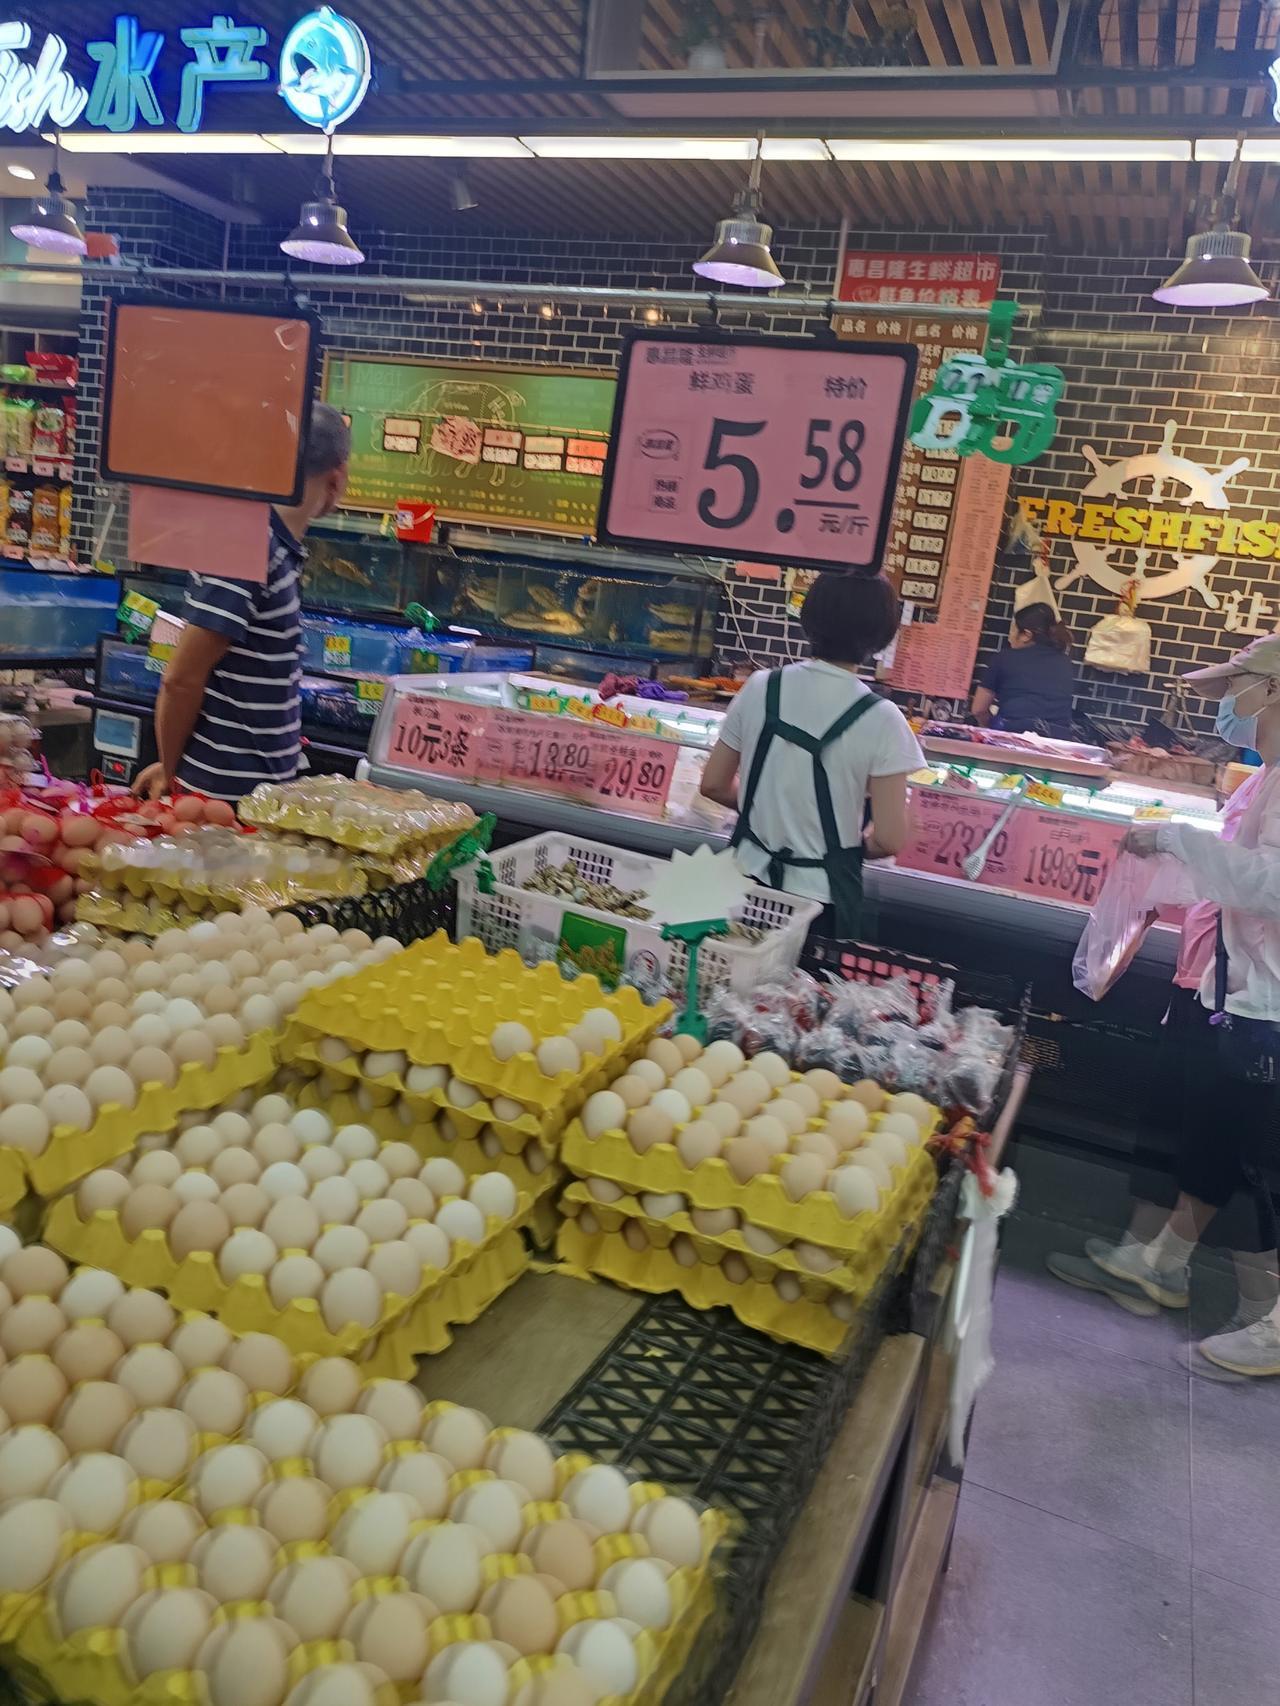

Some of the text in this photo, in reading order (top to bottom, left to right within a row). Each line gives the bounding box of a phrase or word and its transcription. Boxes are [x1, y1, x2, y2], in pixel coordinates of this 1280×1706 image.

[84, 15, 269, 133] 水产
[824, 377, 867, 398] 特价
[819, 513, 869, 535] 元/斤
[394, 722, 470, 767] 10元3条
